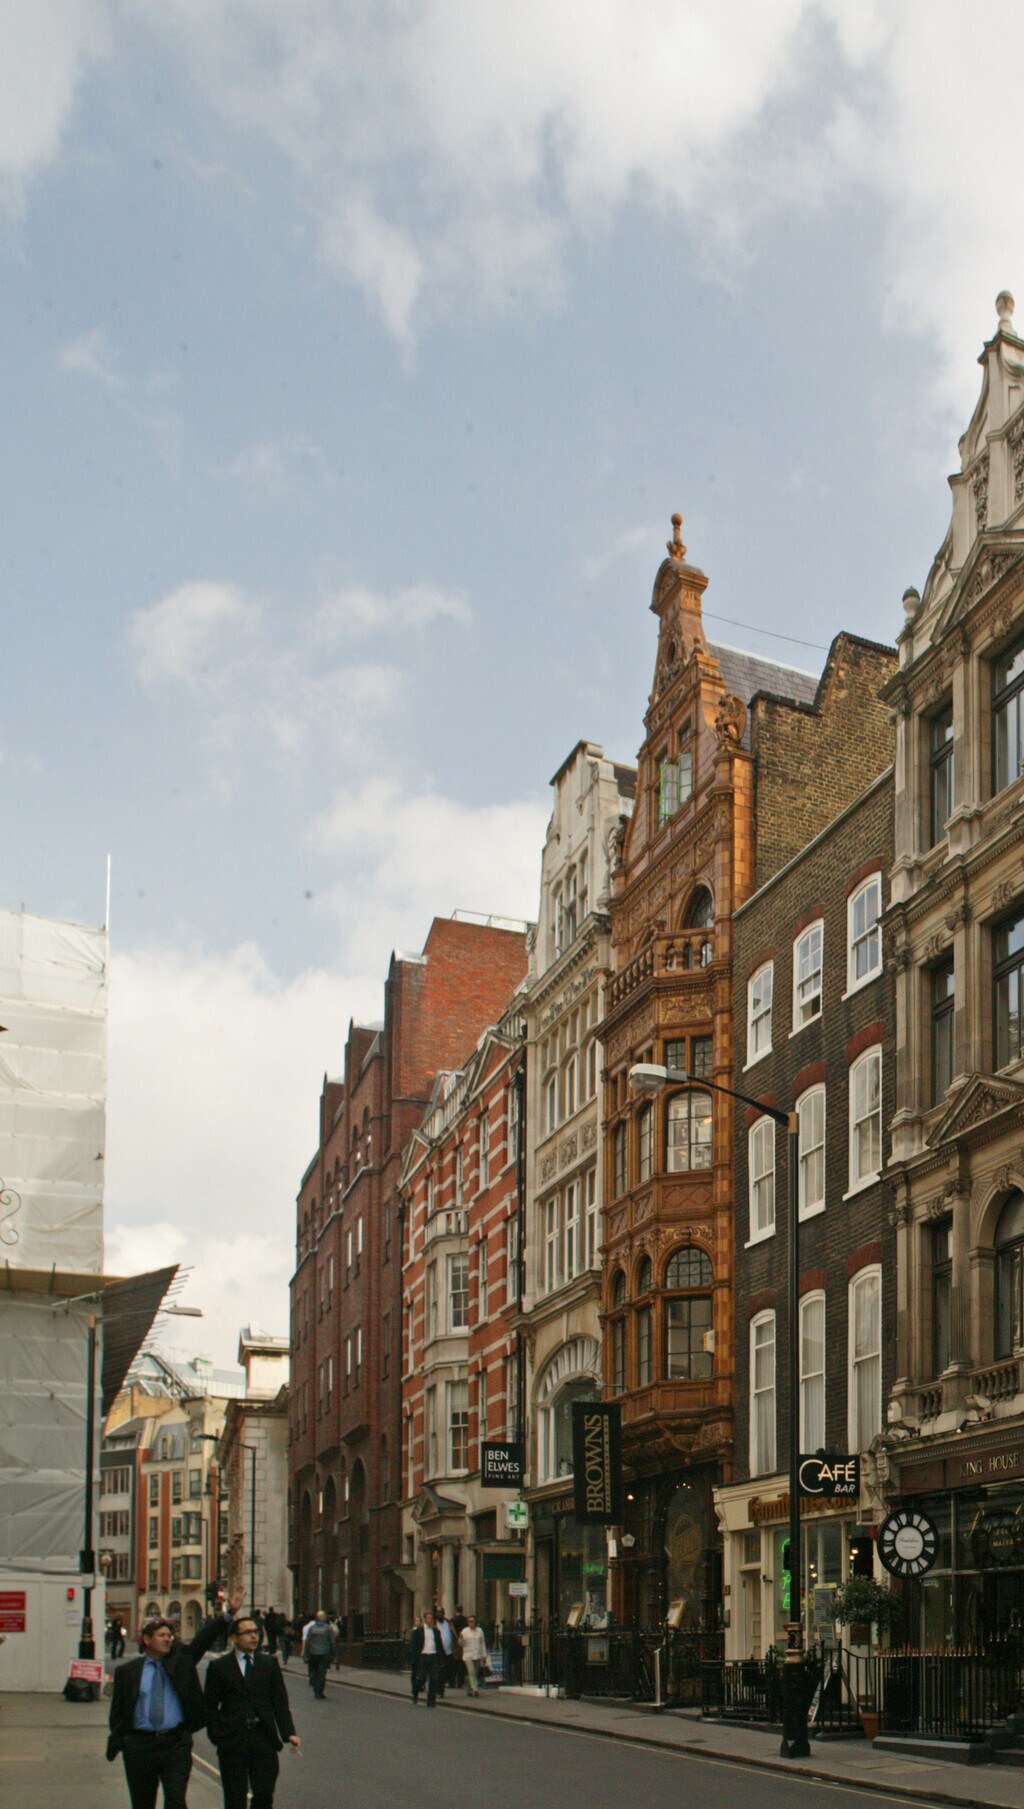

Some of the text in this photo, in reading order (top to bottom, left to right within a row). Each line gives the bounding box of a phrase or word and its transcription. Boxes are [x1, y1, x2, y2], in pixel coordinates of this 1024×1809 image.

[488, 1450, 509, 1460] BEN
[989, 1452, 1019, 1472] HOUSE
[488, 1461, 520, 1473] ELWES
[584, 1414, 604, 1513] BROWNS
[798, 1459, 856, 1493] CAFÉ
[834, 1484, 856, 1494] BAR
